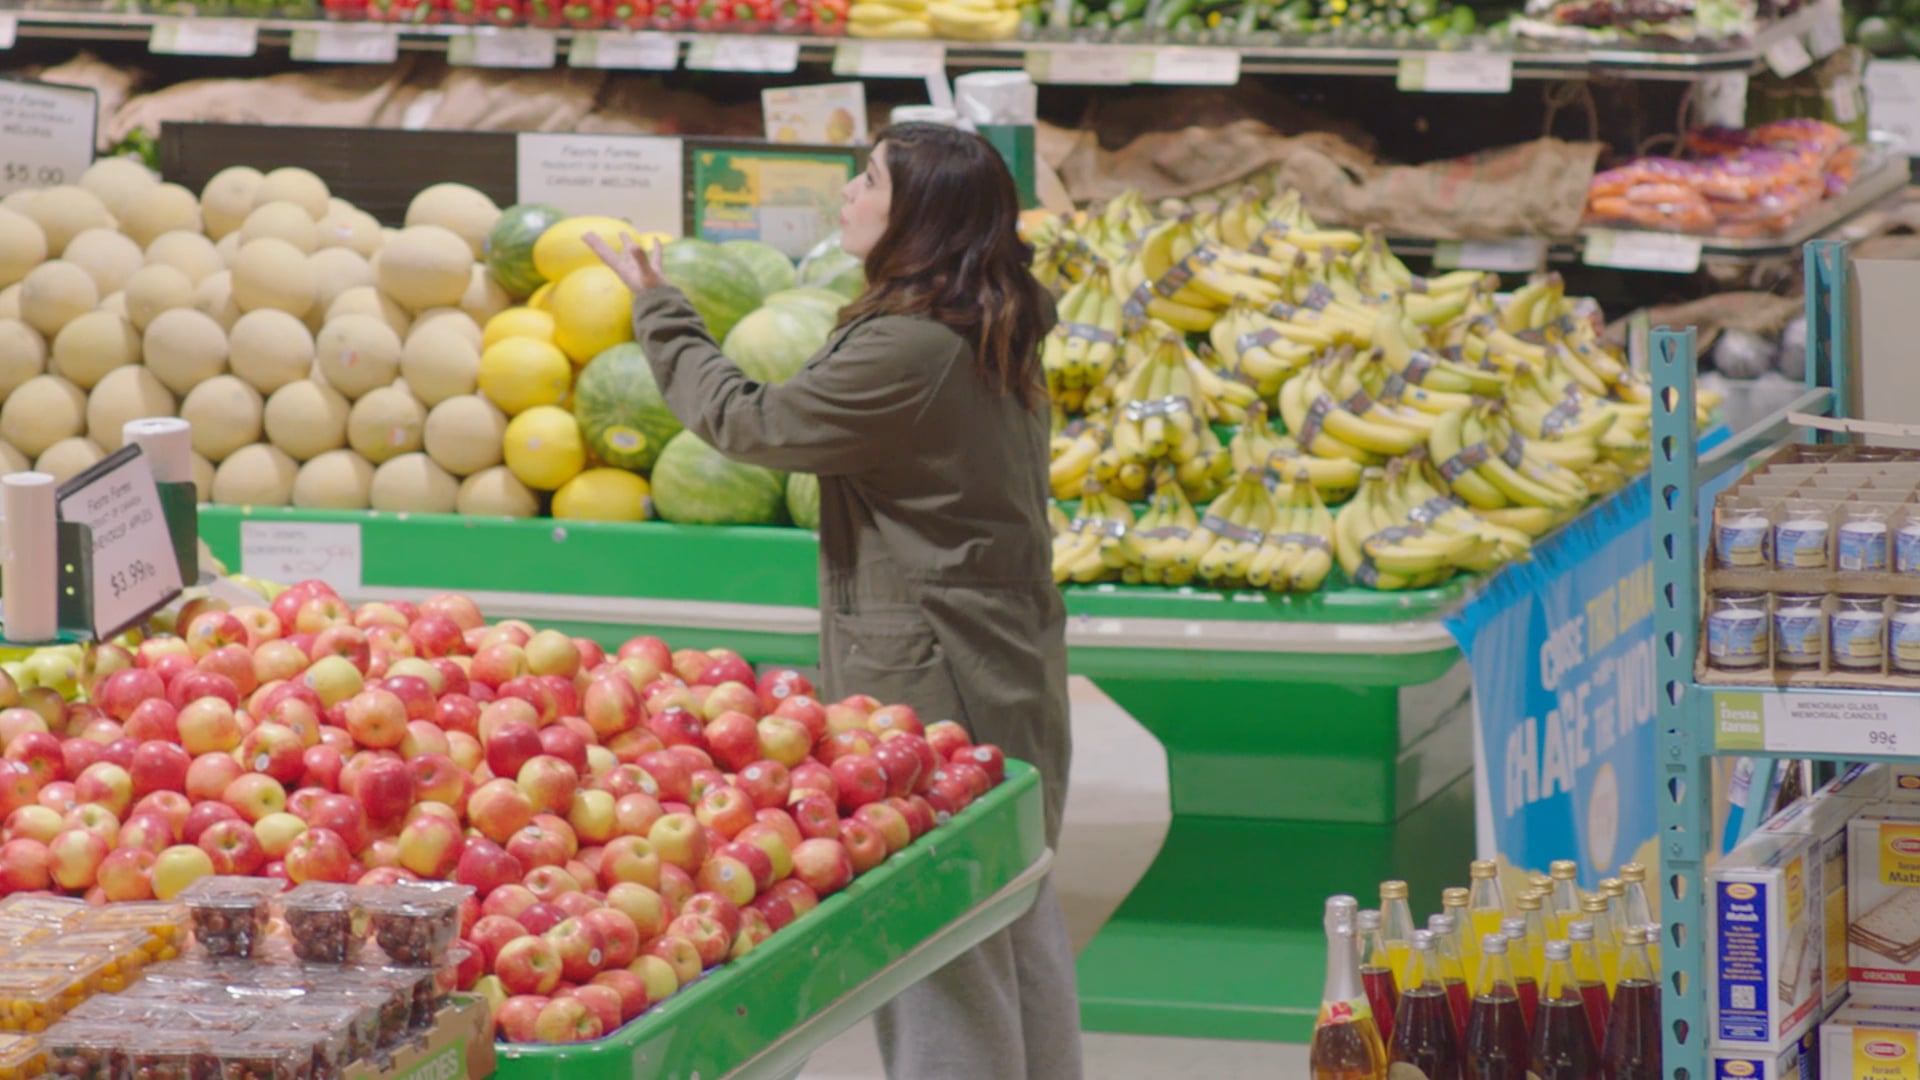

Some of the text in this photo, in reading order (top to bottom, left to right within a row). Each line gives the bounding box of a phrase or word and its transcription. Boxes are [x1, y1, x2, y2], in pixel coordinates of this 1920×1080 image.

[5, 162, 65, 185] $5.00
[1797, 702, 1880, 711] MENORAH GLASS
[1791, 711, 1888, 721] MEMORIAL CANDLES
[1868, 730, 1897, 745] 99¢
